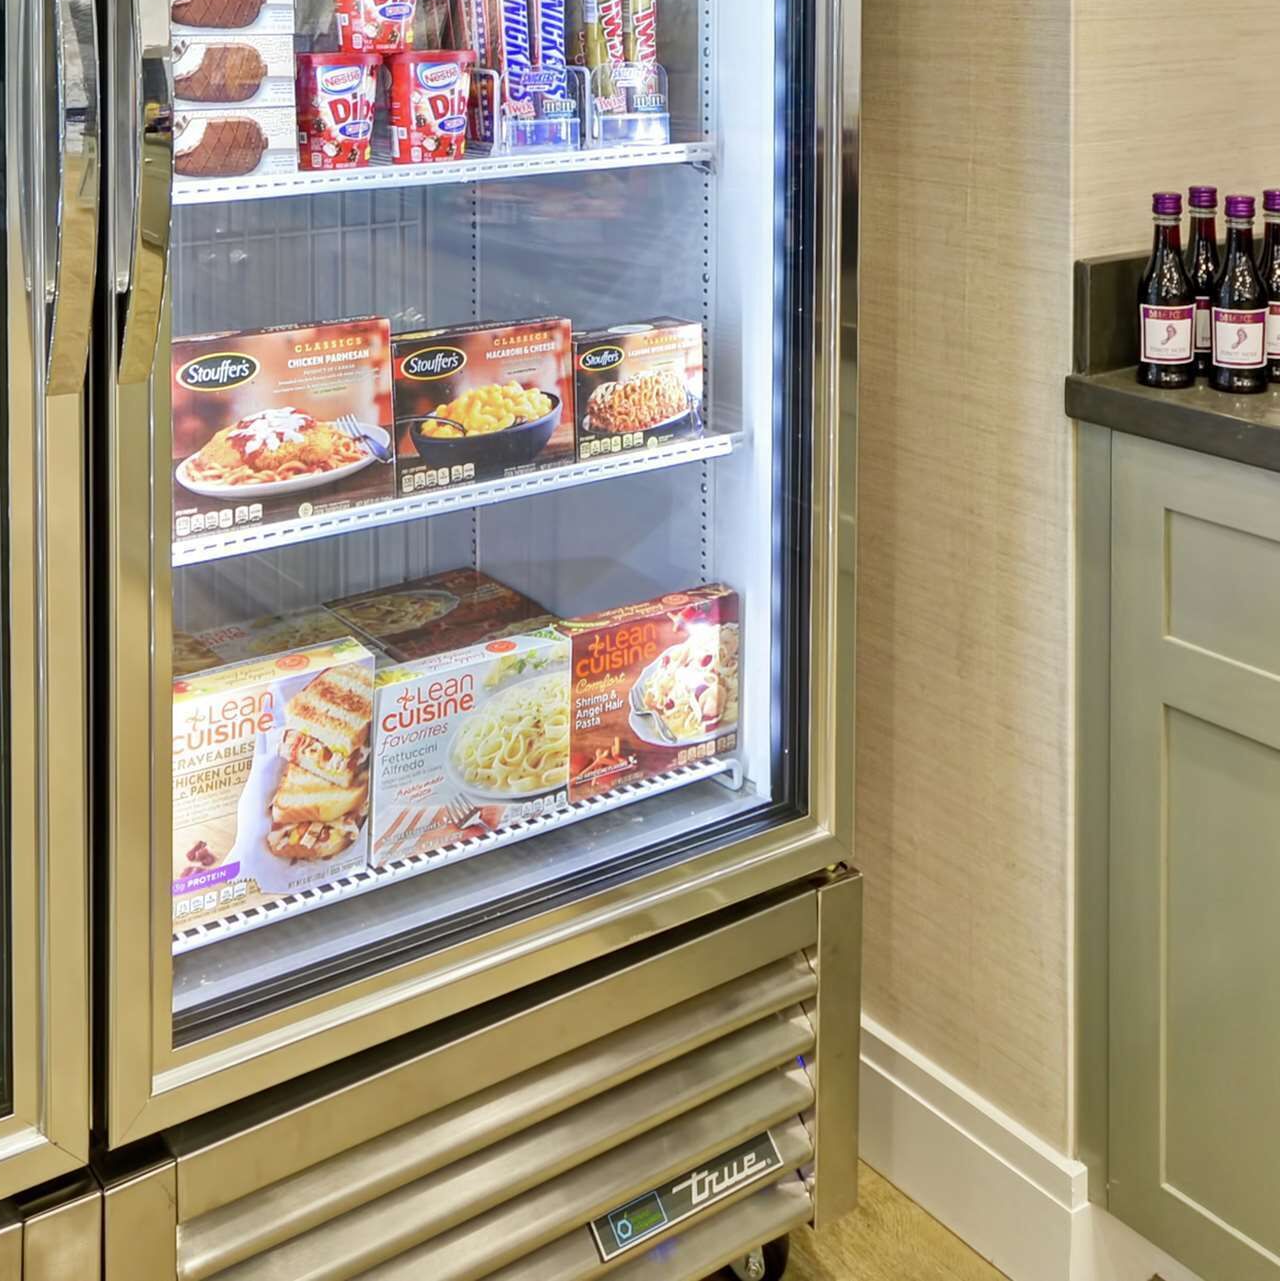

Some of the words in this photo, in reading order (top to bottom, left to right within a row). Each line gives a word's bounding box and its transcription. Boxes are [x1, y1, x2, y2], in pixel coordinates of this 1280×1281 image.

[329, 93, 375, 123] Dibs
[294, 336, 363, 353] CLASSICS
[494, 332, 549, 346] CLASSICS
[530, 341, 556, 353] CHEESE
[288, 355, 324, 368] CHICKEN
[325, 349, 369, 364] PARMESAN
[409, 353, 459, 374] Stouffer's
[585, 350, 619, 367] Stouffer's
[187, 358, 250, 385] Stouffer's
[606, 623, 657, 652] Lean
[417, 673, 474, 705] Lean
[209, 691, 274, 725] Lean
[576, 692, 609, 709] Shrimp
[576, 705, 603, 721] Angel
[604, 699, 624, 713] Hair
[576, 716, 601, 730] Pasta
[378, 721, 449, 756] favorites
[381, 742, 438, 765] Fettuccini
[224, 760, 253, 776] CLUB
[382, 758, 425, 777] Alfredo
[190, 778, 231, 796] PANINI
[187, 869, 227, 888] PROTEIN
